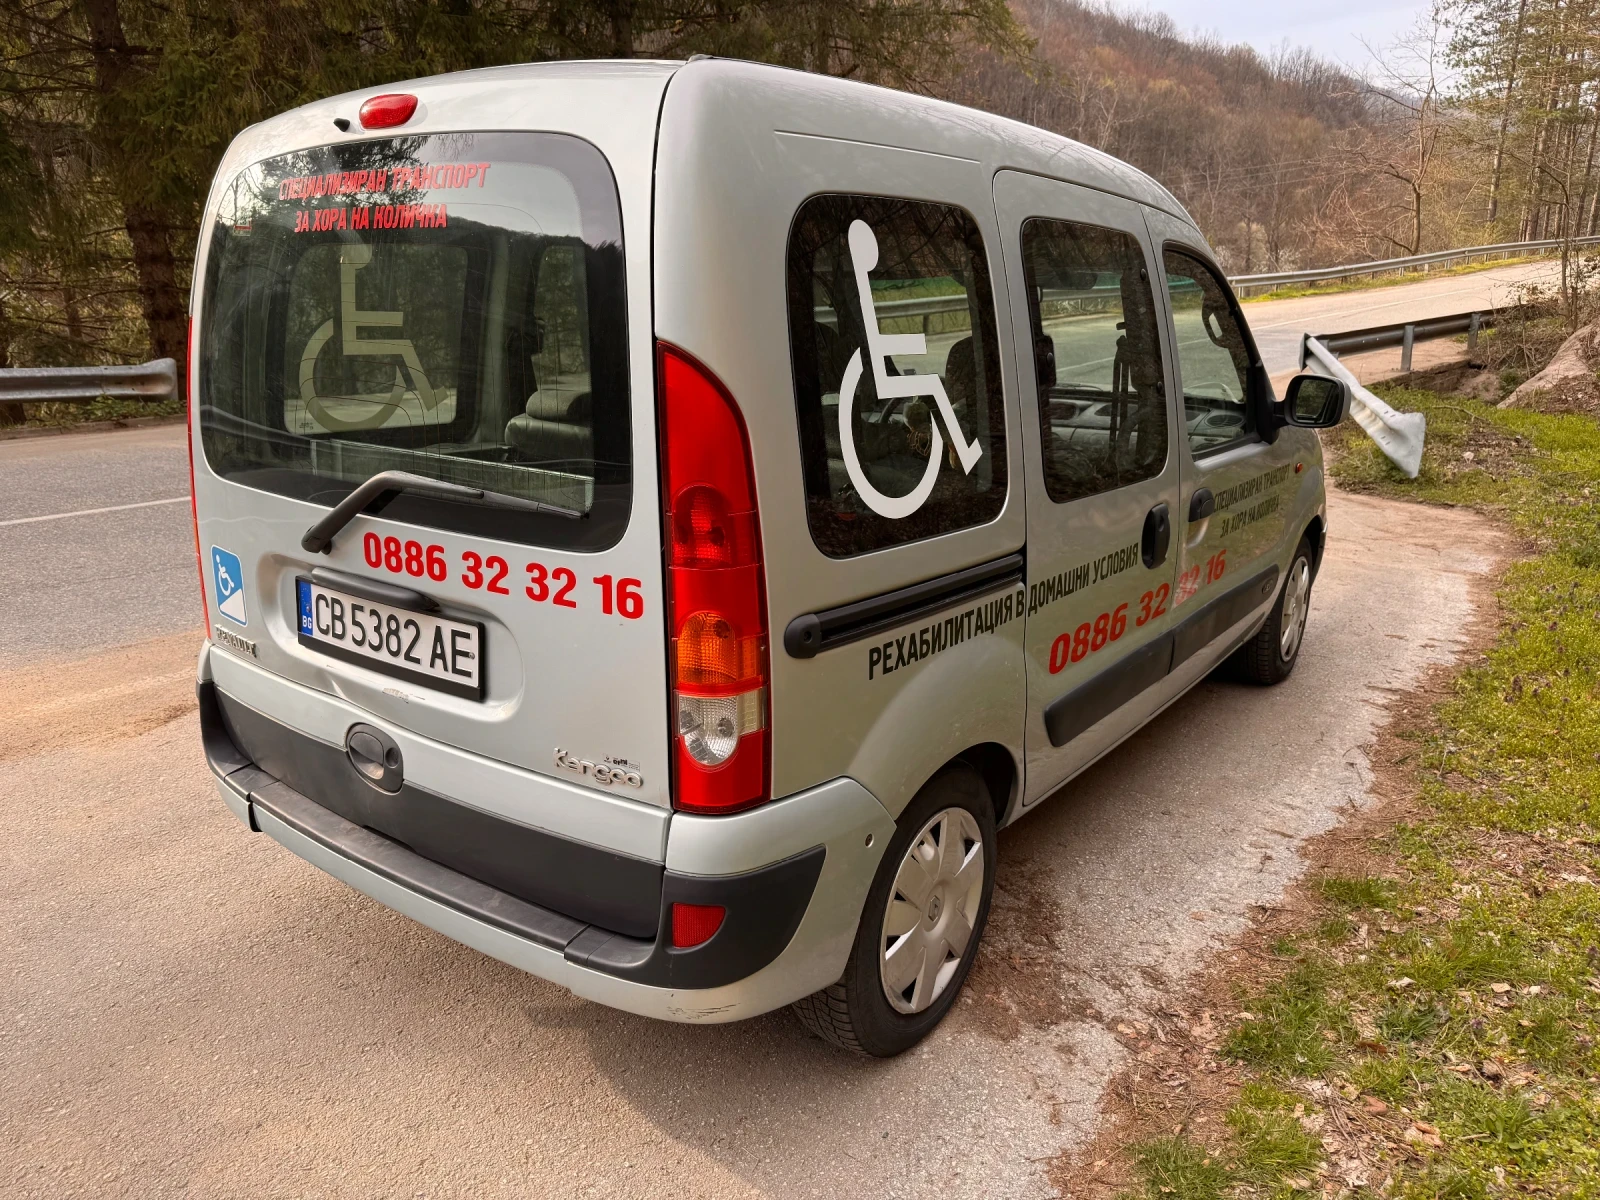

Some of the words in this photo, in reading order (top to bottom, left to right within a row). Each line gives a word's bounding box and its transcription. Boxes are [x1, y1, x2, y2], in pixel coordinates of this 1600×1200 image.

[279, 169, 389, 201] СПЕЦИАЛИЗИРАН
[391, 162, 491, 190] ТРАНСПОРТ
[294, 210, 310, 233] ЗА
[312, 207, 347, 231] ХОРА
[351, 205, 370, 230] НА
[373, 203, 448, 229] КОЛИЧКА
[363, 531, 447, 582] 0886
[461, 550, 510, 595] 32
[525, 562, 577, 608] 32
[593, 574, 644, 619] 16
[302, 615, 312, 630] BG
[868, 592, 1013, 681] РЕХАБИЛИТАЦИЯ
[1015, 589, 1025, 619] В
[1028, 562, 1090, 618] ДОМАШНИ
[1092, 542, 1139, 585] УСЛОВИЯ
[1048, 602, 1129, 675] 0886
[1135, 582, 1170, 627] 32
[1206, 549, 1227, 585] 16
[553, 747, 643, 788] Kangoo
